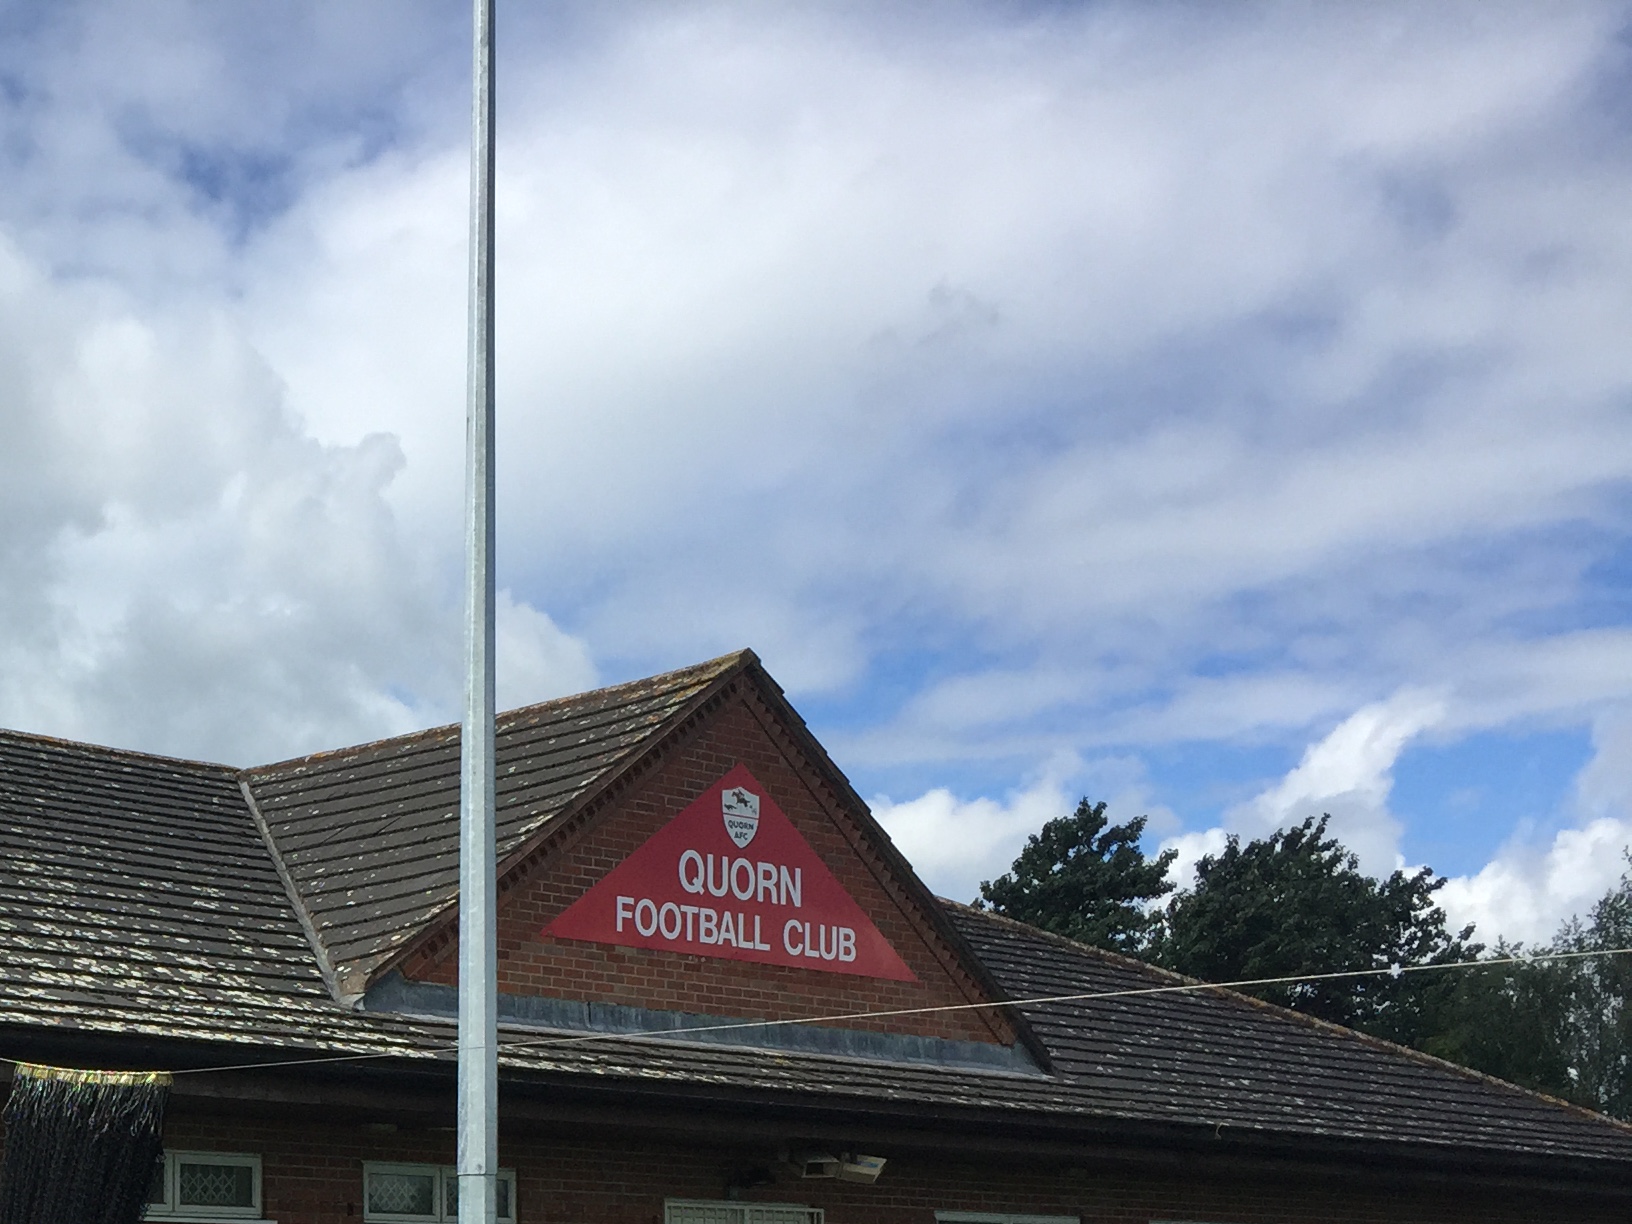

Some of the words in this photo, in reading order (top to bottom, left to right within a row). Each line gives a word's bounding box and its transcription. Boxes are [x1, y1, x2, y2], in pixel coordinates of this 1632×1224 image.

[728, 820, 754, 830] QUORN
[734, 831, 748, 841] AFC
[679, 850, 801, 907] QUORN
[616, 896, 770, 951] FOOTBALL
[783, 919, 856, 962] CLUB
